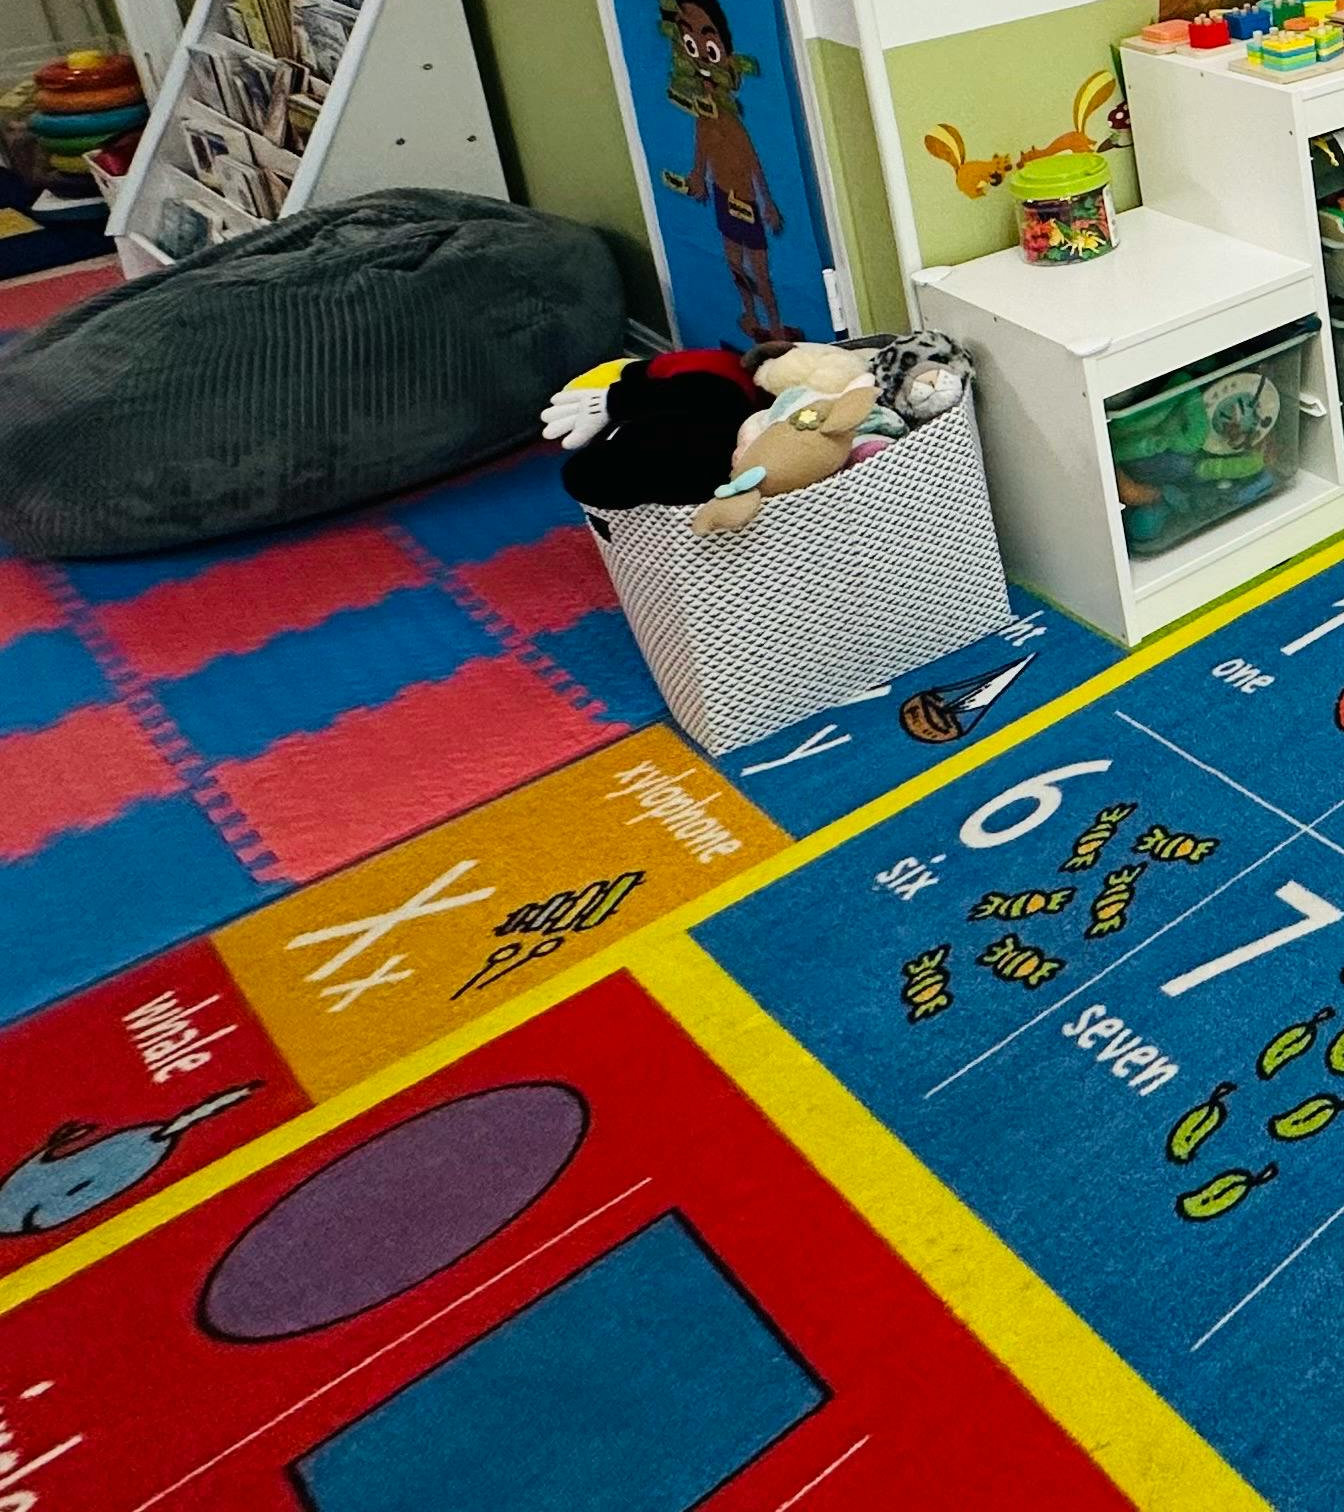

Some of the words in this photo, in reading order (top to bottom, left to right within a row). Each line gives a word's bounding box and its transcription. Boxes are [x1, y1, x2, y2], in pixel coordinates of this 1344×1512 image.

[1212, 658, 1275, 693] one
[613, 760, 742, 863] xylophone
[959, 760, 1112, 849] 6
[872, 854, 941, 900] six
[1160, 881, 1344, 997] 7
[122, 991, 238, 1083] whale
[1062, 1004, 1179, 1096] seven
